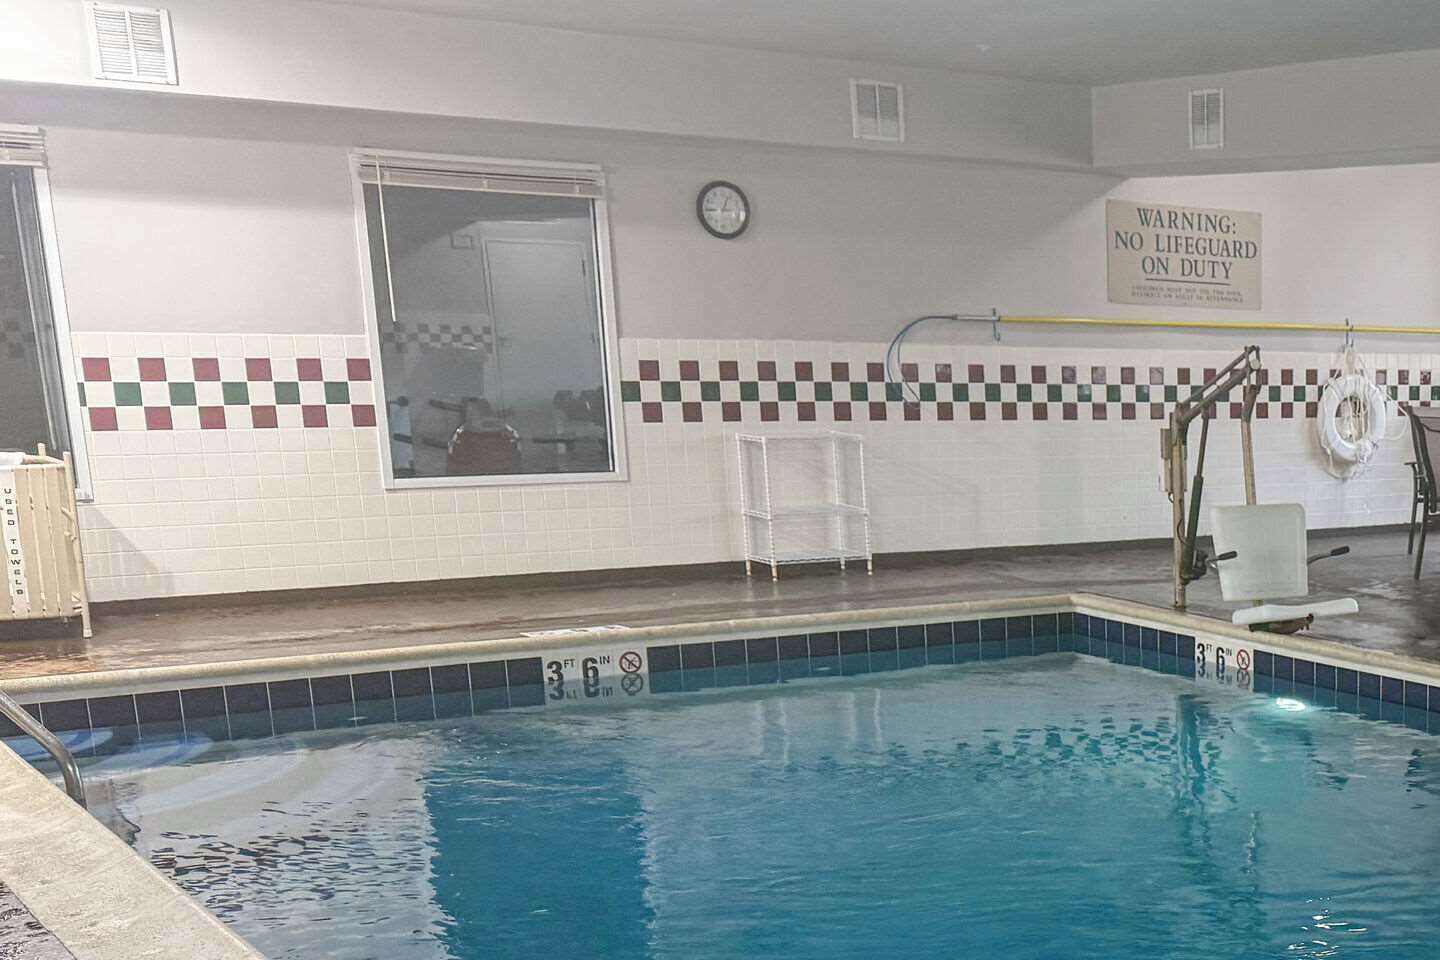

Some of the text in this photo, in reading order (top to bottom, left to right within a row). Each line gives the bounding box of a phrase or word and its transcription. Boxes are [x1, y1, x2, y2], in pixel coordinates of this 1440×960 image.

[1137, 207, 1236, 235] WARNING:
[1114, 230, 1258, 259] NO LIFEGUARD
[1141, 255, 1233, 280] ON DUTY
[4, 488, 16, 526] USED
